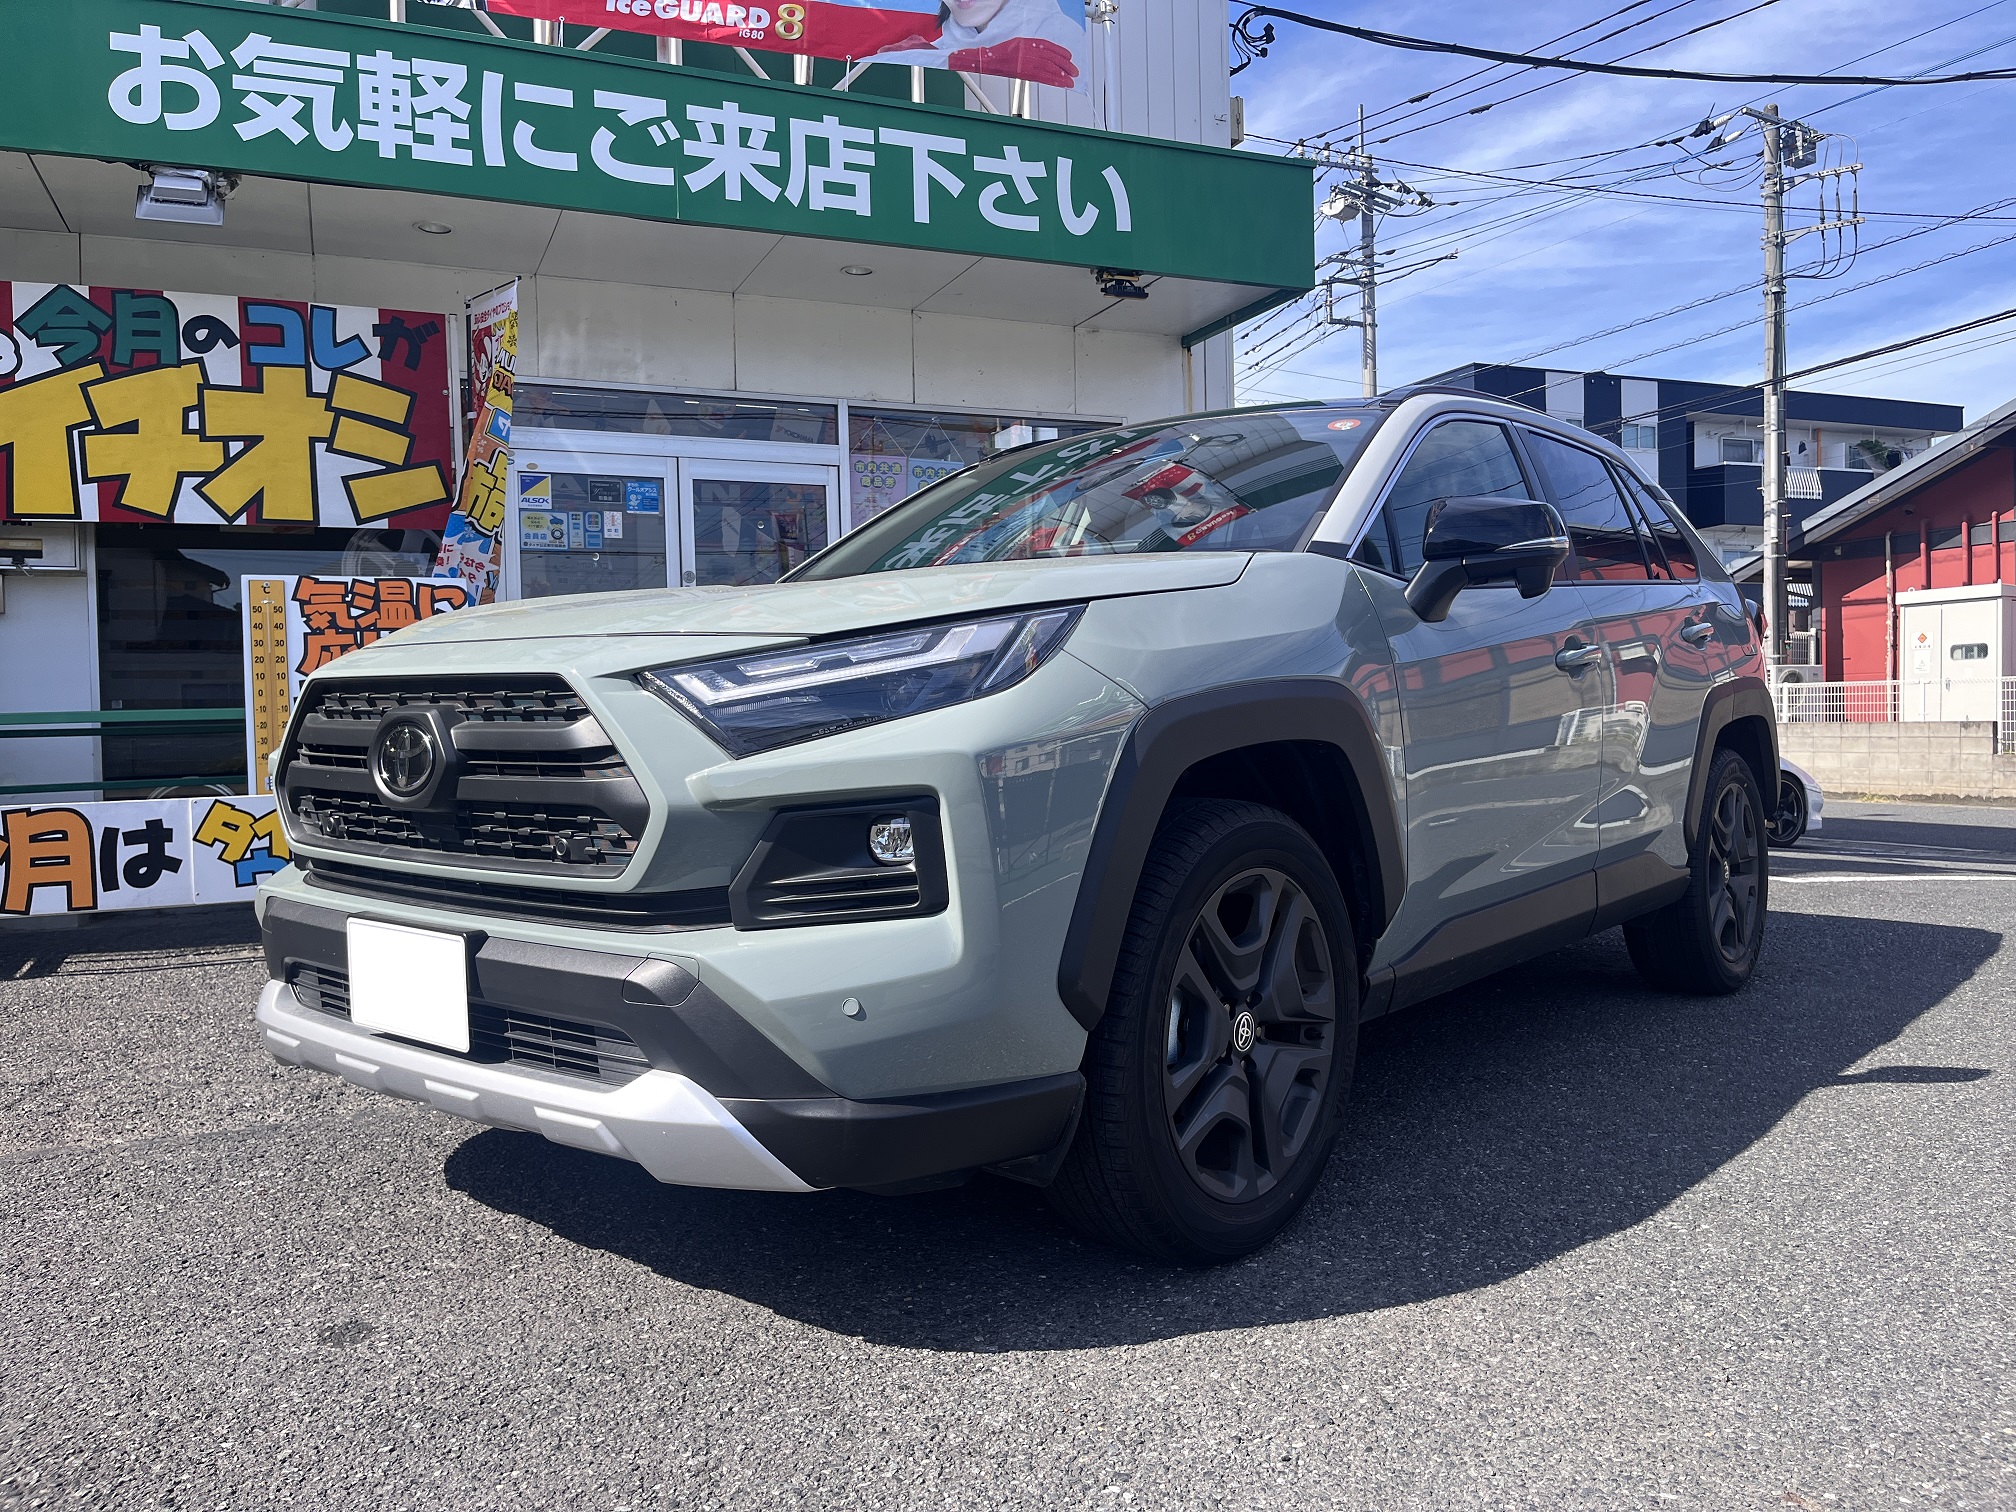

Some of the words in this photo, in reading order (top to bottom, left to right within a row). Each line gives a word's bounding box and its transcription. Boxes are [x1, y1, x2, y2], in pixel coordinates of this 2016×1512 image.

[775, 4, 805, 40] 8
[739, 28, 764, 40] iG80
[107, 23, 1131, 236] お気軽にご来店下さい
[0, 356, 453, 526] イチオシ
[854, 460, 902, 475] 市内共通
[861, 475, 896, 488] 商品券
[524, 532, 548, 541] 会員店
[252, 605, 262, 614] 50
[273, 605, 283, 614] 50
[291, 575, 467, 632] 気温に
[253, 622, 263, 630] 40
[274, 622, 284, 630] 40
[254, 639, 264, 647] 30
[274, 639, 285, 647] 30
[254, 656, 265, 664] 20
[275, 656, 286, 664] 20
[255, 672, 265, 680] 10
[276, 672, 286, 680] 10
[258, 689, 264, 697] 0
[279, 688, 285, 697] 0
[0, 807, 183, 915] 月は
